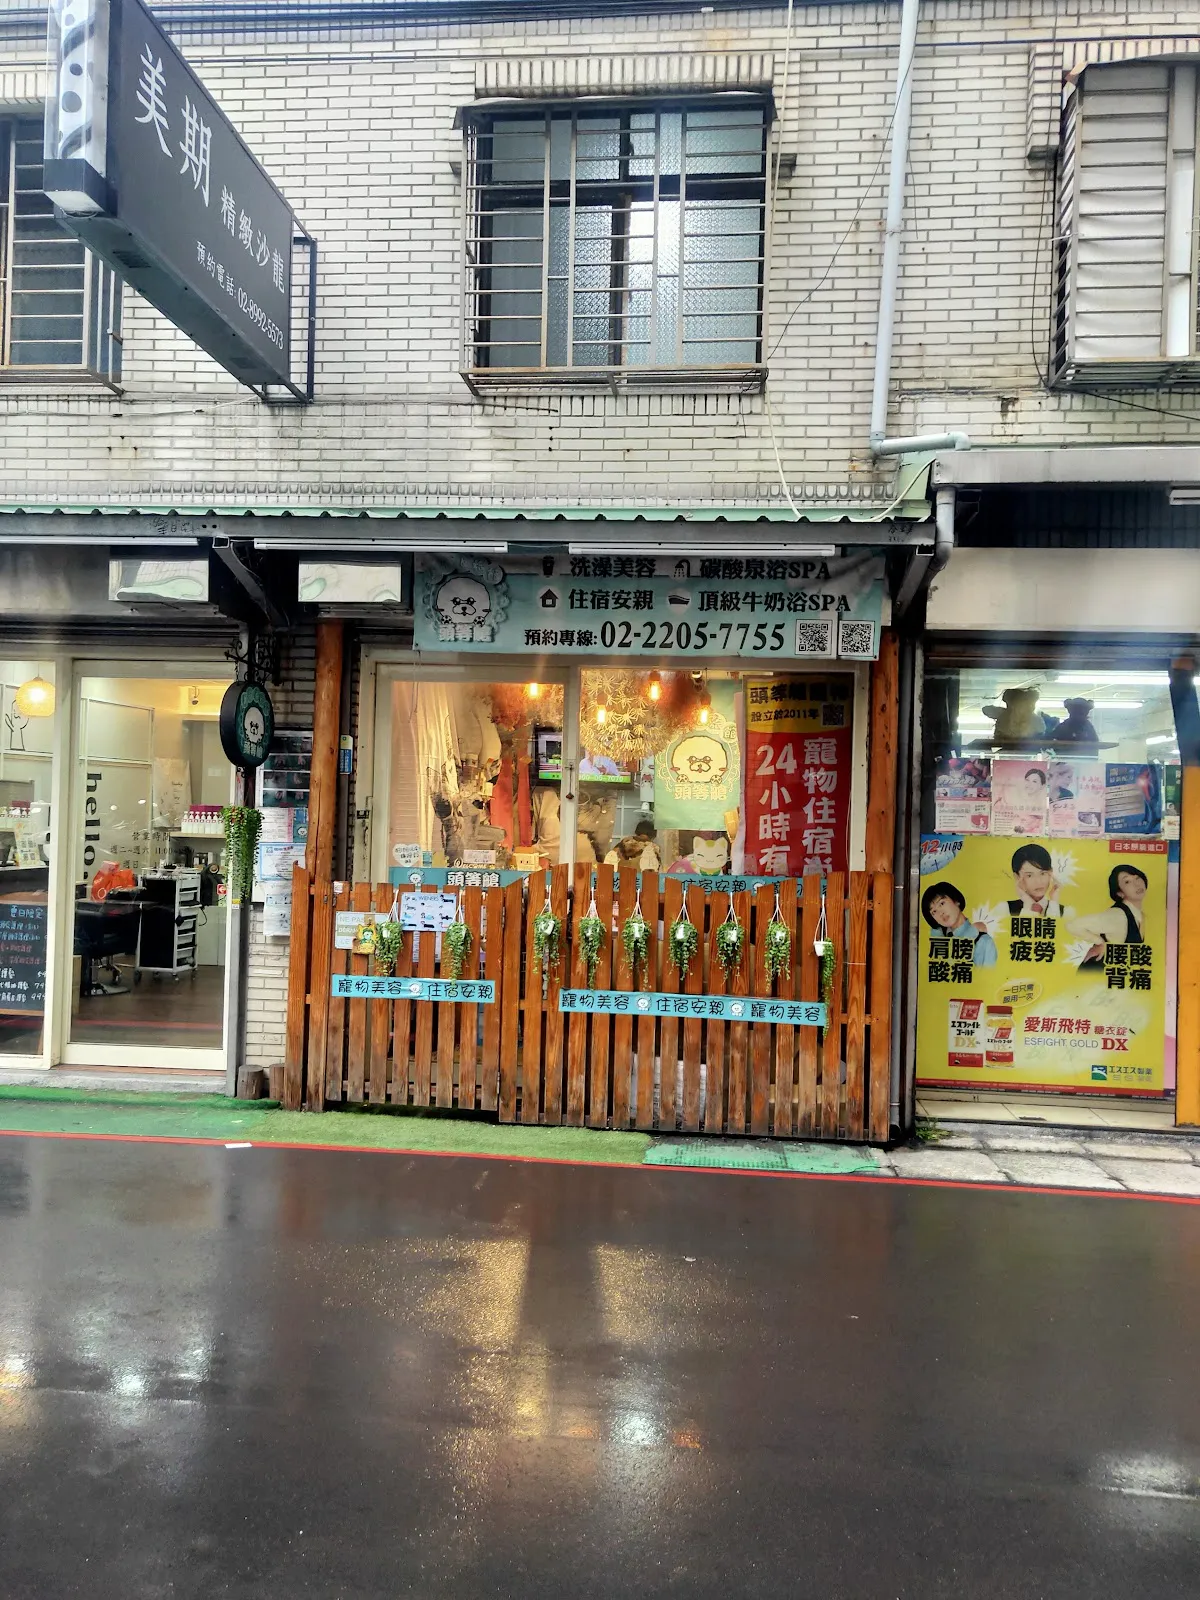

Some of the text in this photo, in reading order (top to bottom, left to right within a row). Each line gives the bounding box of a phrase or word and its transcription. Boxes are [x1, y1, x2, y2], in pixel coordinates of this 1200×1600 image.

[134, 42, 213, 208] 美期
[220, 184, 286, 294] 精緻沙龍
[237, 286, 284, 350] 02-8992-5573
[569, 556, 831, 581] 洗澡美容 碳酸泉浴SPA
[568, 589, 852, 613] 住宿安親 頂級牛奶浴SPA
[524, 619, 786, 651] 預約專線: 02-2205-7755
[83, 772, 102, 880] hello.
[1010, 917, 1057, 939] 眼睛
[928, 937, 974, 960] 肩膀
[1010, 941, 1056, 963] 疲勞
[1105, 944, 1152, 967] 腰酸
[928, 962, 973, 984] 酸痛
[1105, 968, 1152, 991] 背痛
[338, 978, 493, 1000] 寵物美容 住宿安親
[562, 993, 821, 1022] 寵物美容 住宿安親 寵物美容
[1024, 1016, 1128, 1036] 愛斯飛特 糖衣錠
[954, 1036, 977, 1048] DX
[1024, 1037, 1129, 1051] ESFIGHT GOLD DX
